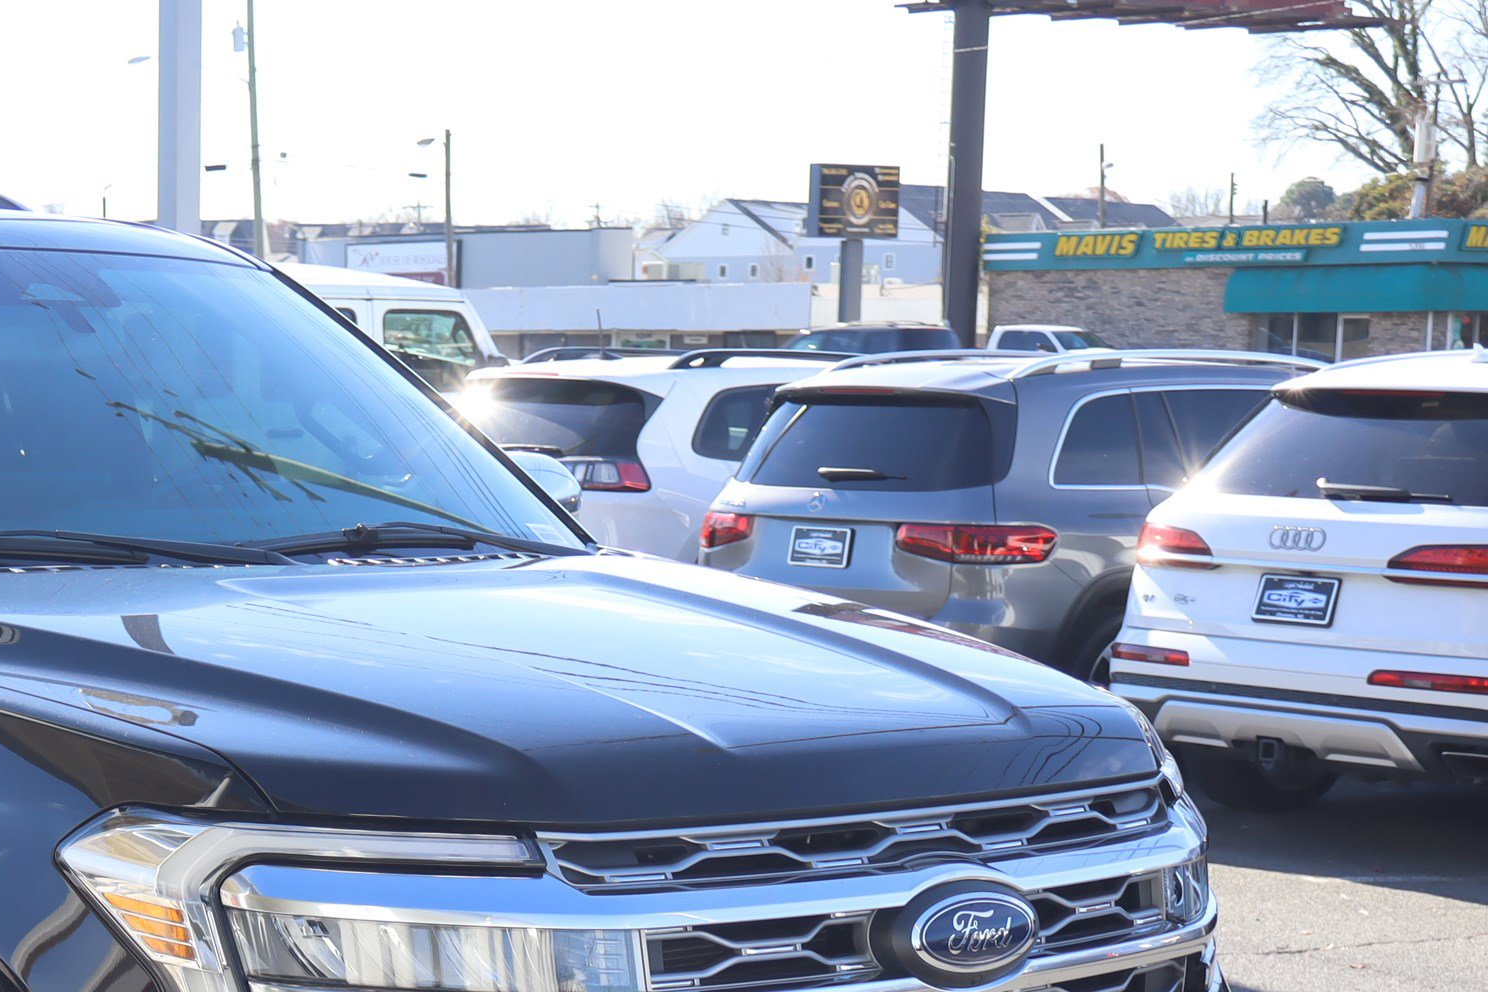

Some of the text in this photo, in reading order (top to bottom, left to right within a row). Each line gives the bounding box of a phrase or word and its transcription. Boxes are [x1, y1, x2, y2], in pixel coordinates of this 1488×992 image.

[1055, 227, 1341, 256] MAVIS TIRES & BRAKES
[1195, 253, 1254, 263] DISCOUNT
[1257, 252, 1302, 261] PRICES
[1267, 593, 1304, 607] City
[948, 909, 1012, 955] Ford
